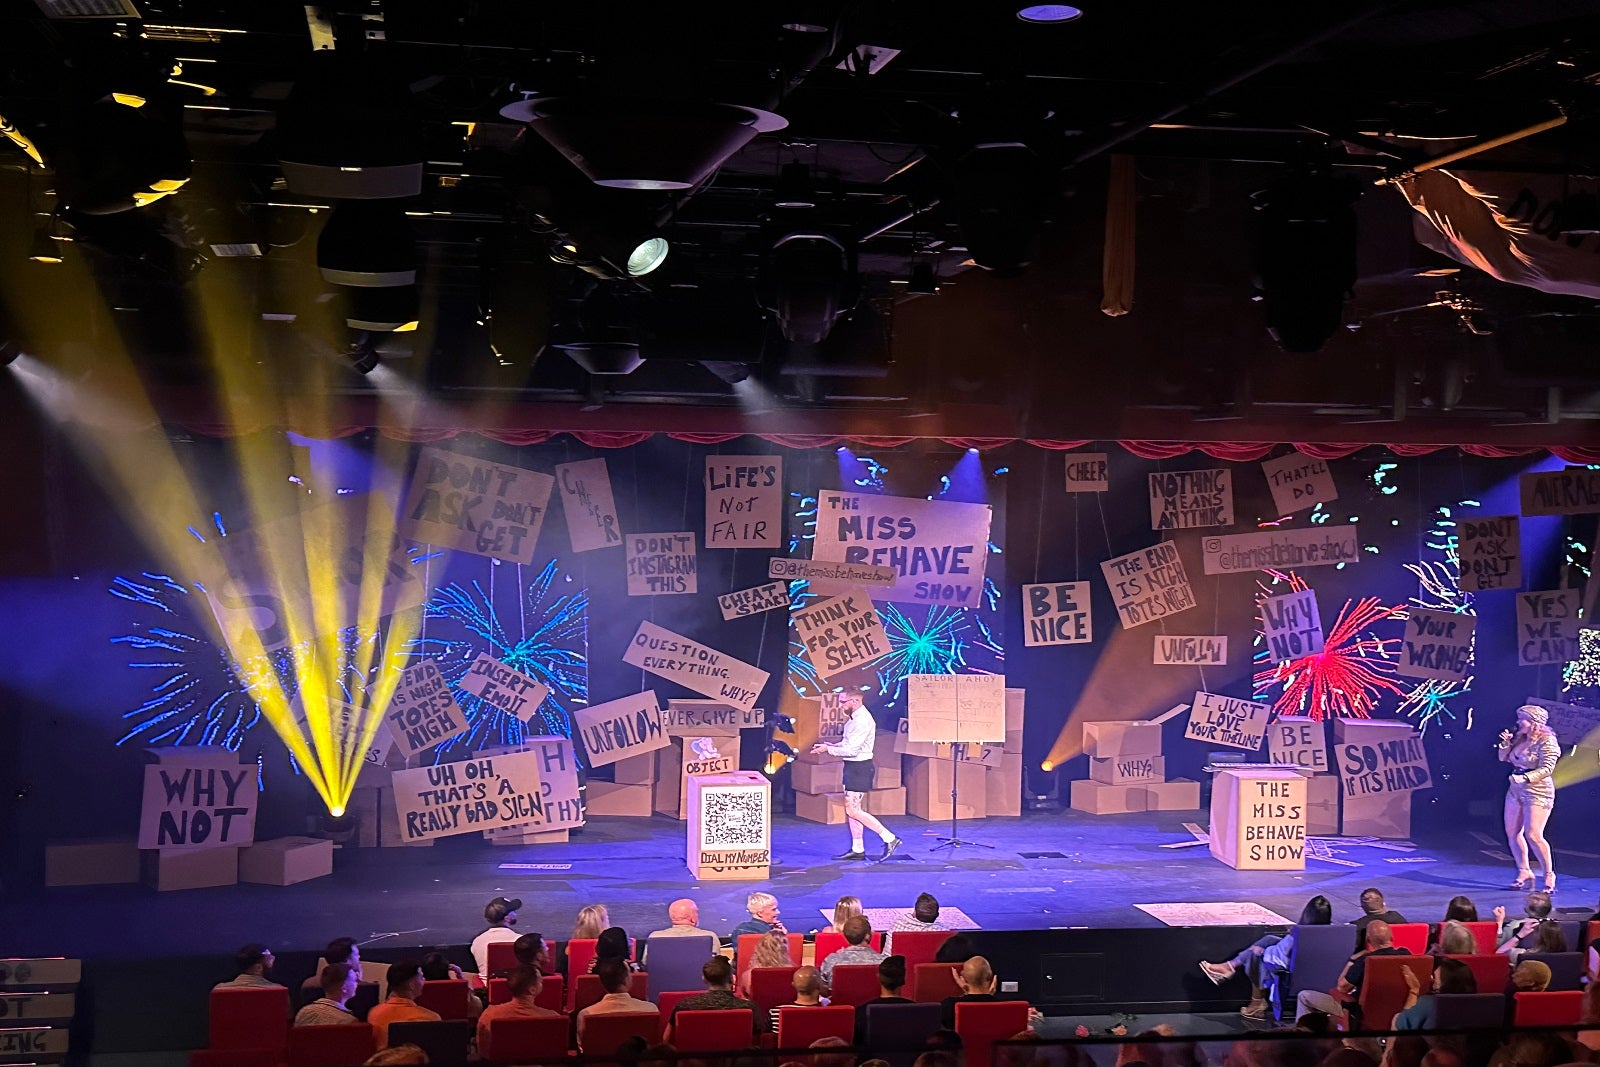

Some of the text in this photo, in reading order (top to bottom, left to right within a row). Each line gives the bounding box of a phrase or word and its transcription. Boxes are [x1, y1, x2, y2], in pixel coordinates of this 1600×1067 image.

[1066, 460, 1107, 482] CHEER
[1151, 469, 1225, 498] NOTHING
[828, 496, 859, 510] THE
[1164, 493, 1223, 511] MEANS
[1292, 483, 1314, 500] DO
[410, 488, 483, 532] ASK
[476, 519, 528, 555] GET
[712, 520, 767, 542] FAIR
[838, 516, 916, 541] MISS
[635, 534, 690, 554] DON'T
[1474, 539, 1507, 555] ASK
[628, 554, 696, 576] INSTAGRAM
[846, 545, 973, 577] BEHAVE
[1110, 544, 1176, 576] THE END
[645, 575, 687, 593] THIS
[914, 581, 971, 602] SHOW
[1116, 577, 1142, 599] IS
[1477, 572, 1506, 590] GET
[721, 585, 777, 611] CHEAT
[735, 591, 789, 616] SMART
[1029, 584, 1078, 618] BE
[1119, 594, 1166, 624] TOTES
[1523, 594, 1569, 619] YES
[796, 596, 860, 631] THINK
[1264, 596, 1316, 631] WHY
[805, 611, 878, 653] FOR YOUR
[1030, 612, 1088, 643] NICE
[1412, 614, 1457, 639] YOUR
[1524, 621, 1562, 639] WE
[635, 633, 720, 666] QUESTION
[824, 632, 881, 671] SELFIE
[1270, 626, 1321, 660] NOT
[642, 656, 731, 679] EVERYTHING.
[1405, 641, 1469, 674] WRONG
[404, 664, 436, 687] END
[471, 659, 535, 695] INSERT
[965, 675, 997, 683] AHOY
[391, 693, 407, 707] IS
[409, 676, 443, 702] NIGH
[478, 681, 528, 716] EMOJI
[720, 683, 756, 705] WHY?
[389, 690, 453, 731] TOTES
[702, 709, 736, 726] GIVE
[821, 708, 844, 722] LOL
[1201, 693, 1265, 720] I JUST
[405, 710, 458, 751] NIGH
[583, 704, 663, 755] UNFOLLOW
[1205, 710, 1246, 732] LOVE
[1189, 720, 1261, 749] YOUR TIMELINE
[1281, 725, 1313, 747] BE
[686, 758, 729, 774] OBJECT
[1117, 758, 1152, 778] WHY?
[1272, 748, 1326, 767] NICE
[1344, 739, 1423, 776] SO WHAT
[427, 759, 501, 787] UH OH,
[1345, 776, 1356, 796] IF
[1383, 765, 1429, 792] HARD
[159, 768, 248, 806] WHY
[418, 778, 515, 806] THAT'S A
[1255, 781, 1290, 798] THE
[406, 804, 461, 838] REALLY
[500, 791, 544, 821] SIGN
[1252, 803, 1302, 820] MISS
[157, 807, 249, 845] NOT
[1246, 825, 1304, 841] BEHAVE
[700, 850, 769, 864] DIAL MY NUMBER
[1249, 844, 1305, 861] SHOW
